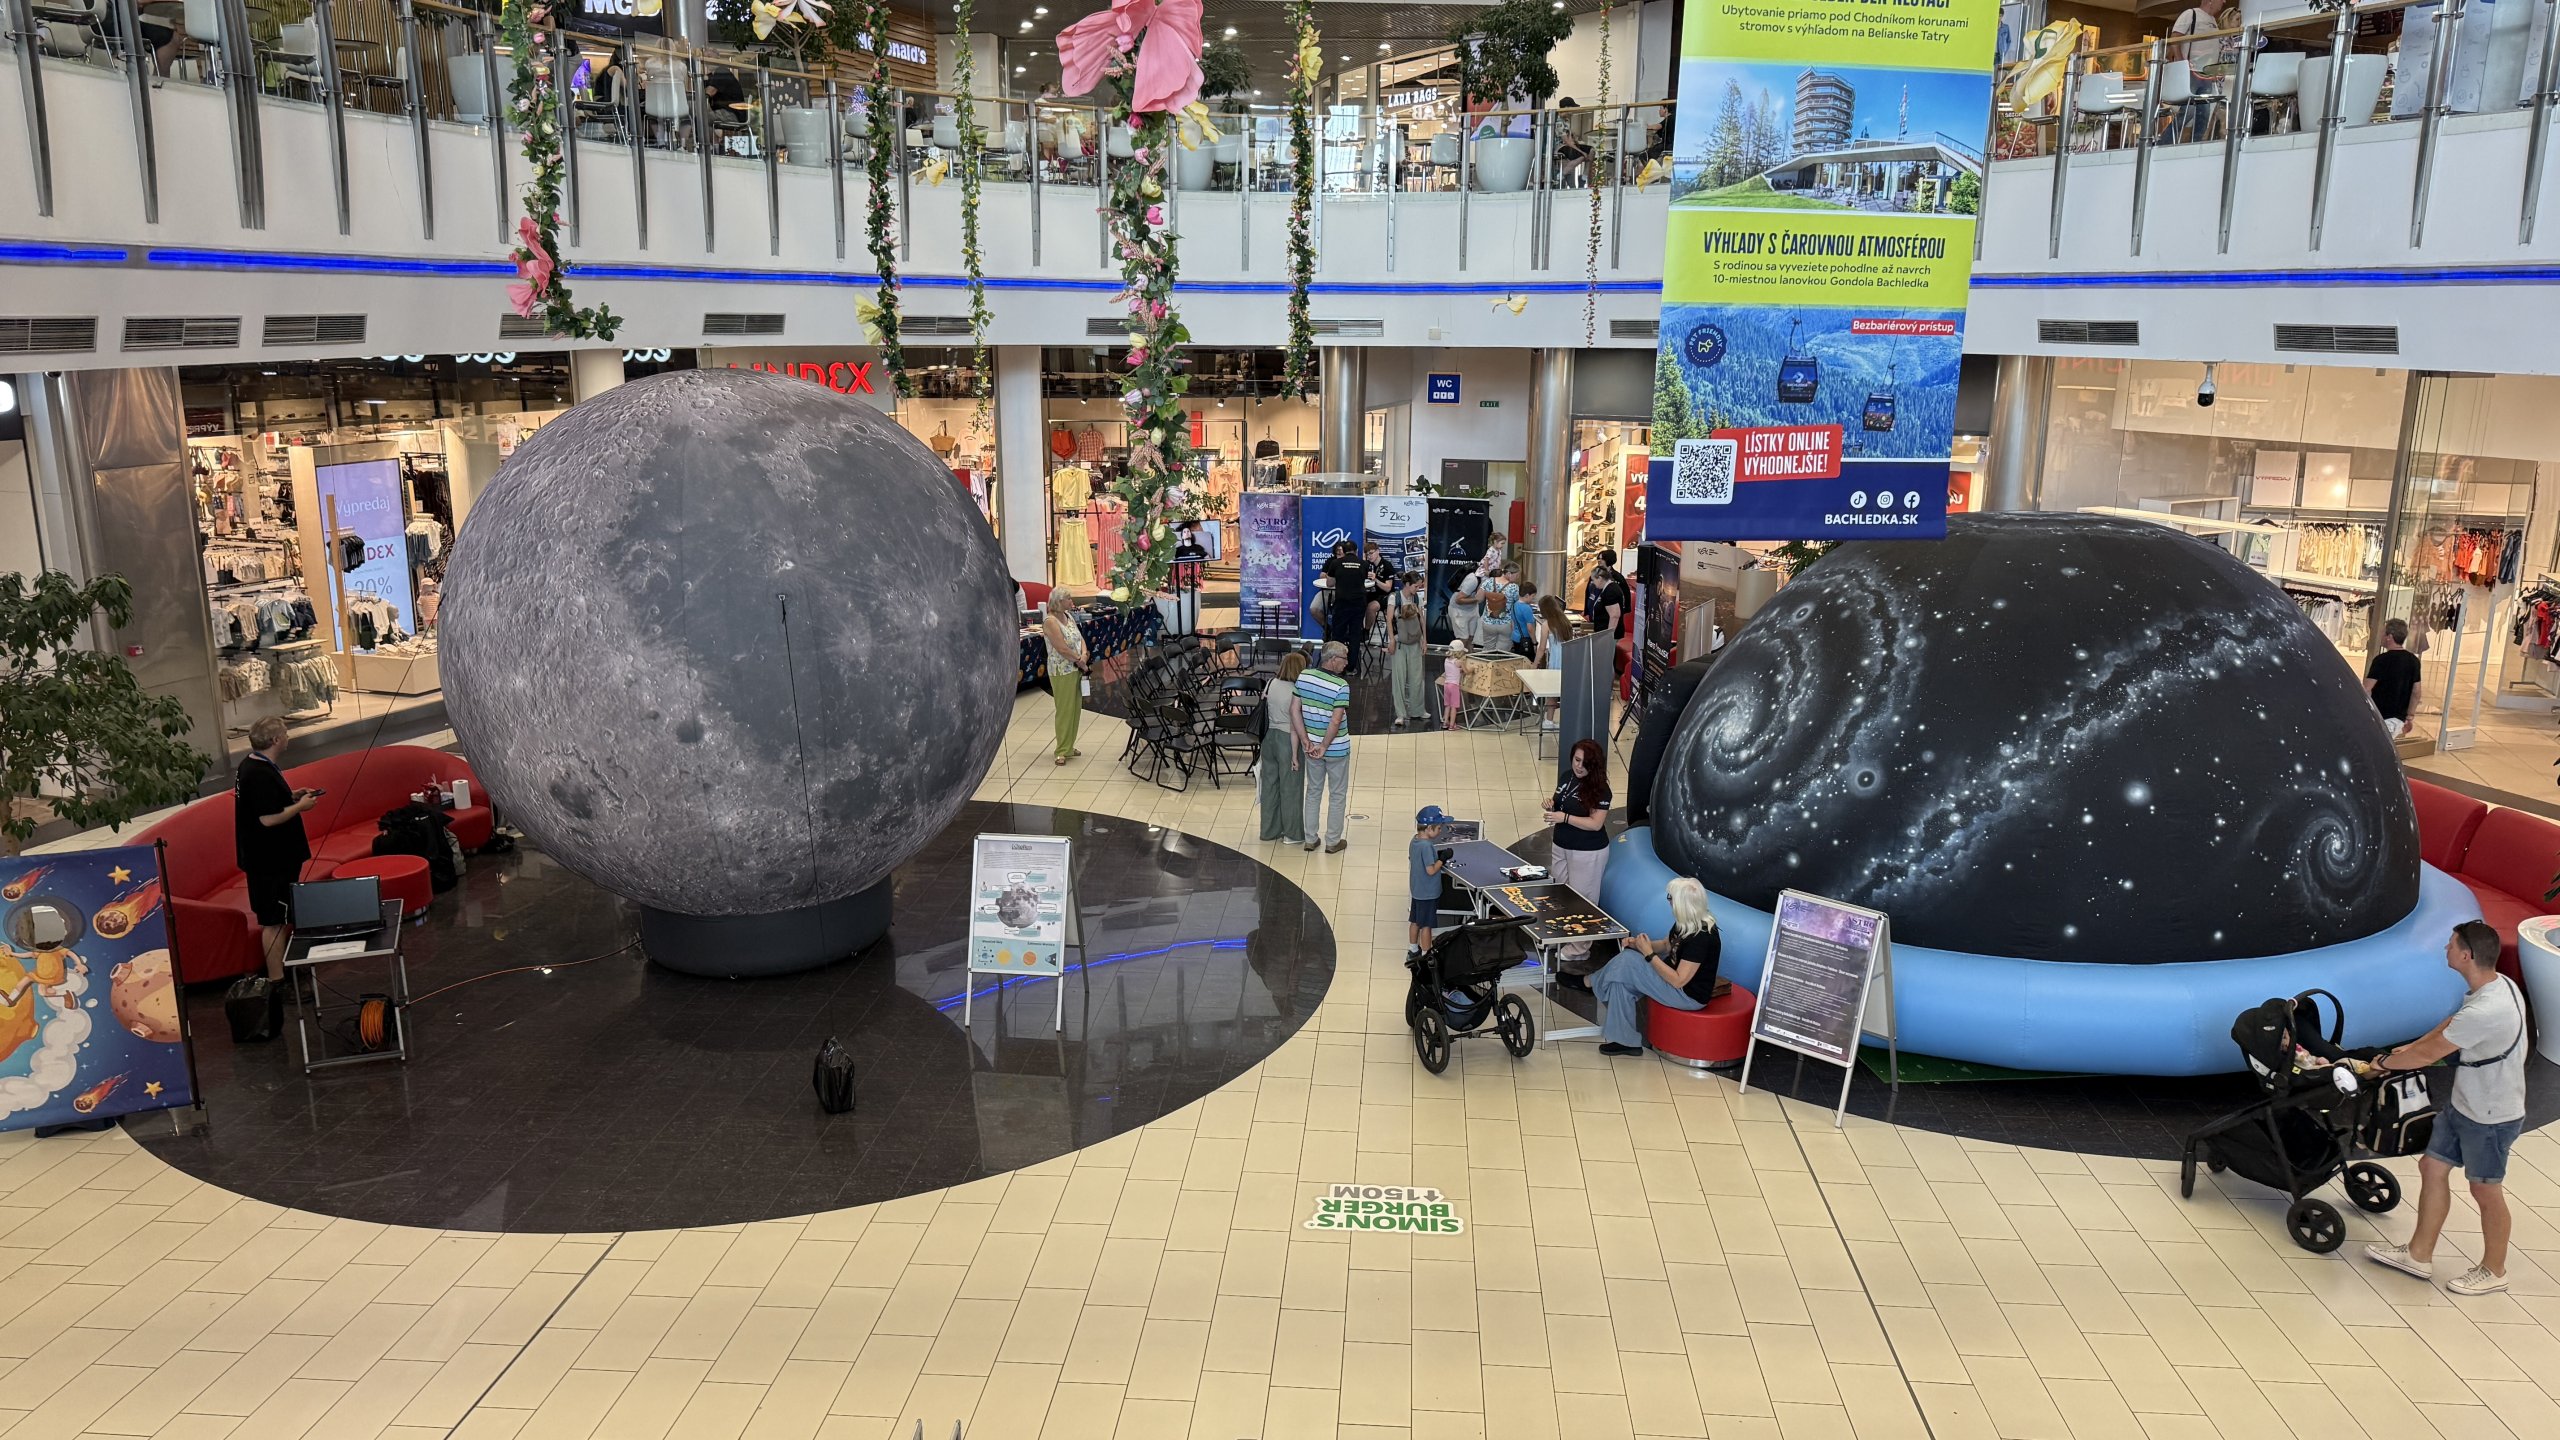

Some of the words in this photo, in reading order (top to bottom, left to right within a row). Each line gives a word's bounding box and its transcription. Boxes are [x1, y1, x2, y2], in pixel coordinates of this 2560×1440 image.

[1721, 4, 1785, 19] Ubytovanie
[1787, 10, 1827, 23] priamo
[1829, 11, 1851, 24] pod
[1853, 12, 1915, 26] Chodníkom
[1917, 16, 1969, 28] korunami
[1739, 23, 1784, 33] stromov
[1787, 25, 1793, 33] s
[1795, 23, 1849, 37] výhľadom
[1851, 28, 1865, 38] na
[1867, 27, 1918, 40] Belianske
[1921, 30, 1950, 43] Tatry
[856, 32, 927, 65] Mcnald's
[1387, 92, 1411, 108] LARA
[1413, 87, 1438, 103] BAGS
[1704, 228, 1765, 255] VÝHĽADY
[1768, 234, 1777, 255] S
[1781, 230, 1854, 257] ČAROVNOU
[1858, 234, 1946, 259] ATMOSFÉROU
[1713, 261, 1720, 270] S
[1723, 261, 1763, 271] rodinou
[1765, 263, 1777, 271] sa
[1779, 263, 1828, 274] vyveziete
[1830, 263, 1879, 276] pohodlne
[1881, 264, 1893, 274] až
[1896, 265, 1931, 275] navrch
[1713, 274, 1777, 285] 10-miestnou
[1779, 275, 1827, 286] lanovkou
[1830, 277, 1874, 287] Gondola
[1876, 278, 1929, 288] Bachledka
[1853, 319, 1917, 334] Bezbariérový
[1918, 322, 1954, 334] prístup
[1698, 328, 1723, 347] FRIENDLY
[728, 362, 874, 394] DEX
[1437, 380, 1452, 388] WC
[1744, 432, 1784, 454] LÍSTKY
[1788, 431, 1831, 452] ONLINE
[1743, 454, 1828, 476] VÝHODNEJŠIE!
[1252, 518, 1288, 526] ASTRO
[1824, 514, 1919, 526] BACHLEDKA.SK
[1334, 1186, 1420, 1200] 150M
[1322, 1199, 1450, 1217] BURGER
[1317, 1214, 1459, 1232] SIMON'S
